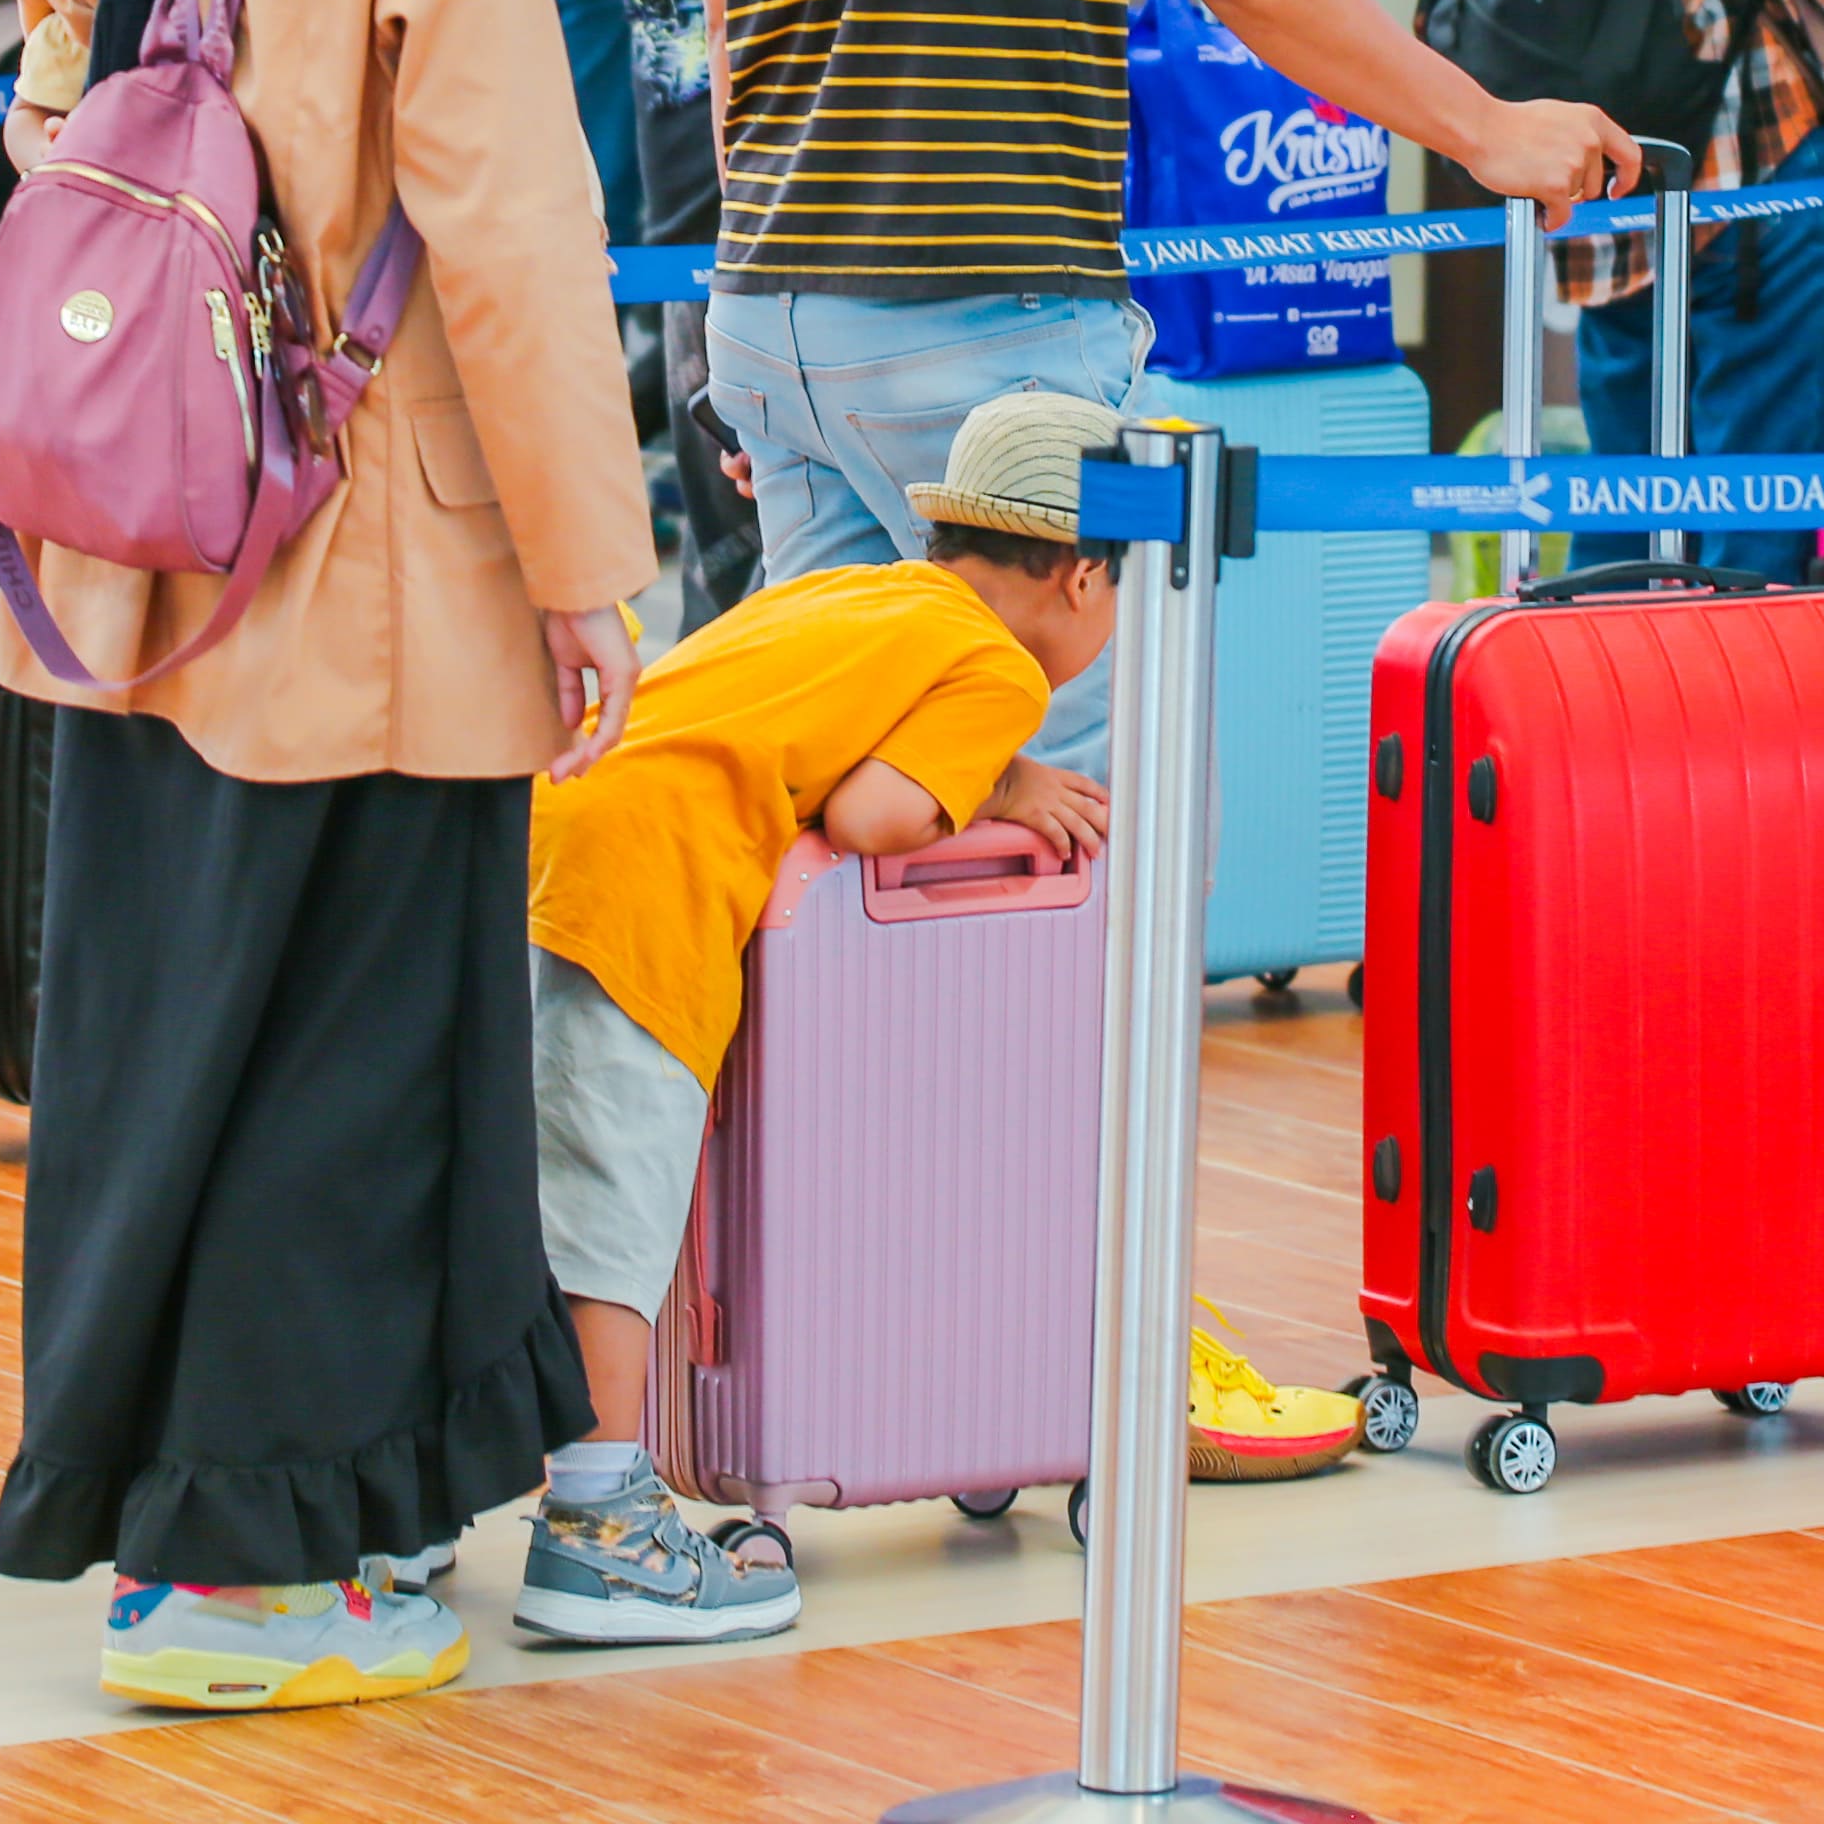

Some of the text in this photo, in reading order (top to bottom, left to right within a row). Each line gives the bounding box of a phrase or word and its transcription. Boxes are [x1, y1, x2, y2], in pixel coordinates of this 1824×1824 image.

[1141, 239, 1224, 272] JAWA
[1224, 232, 1316, 261] BARAT
[1316, 221, 1468, 252] KERTAJATI
[1569, 475, 1735, 516] BANDAR
